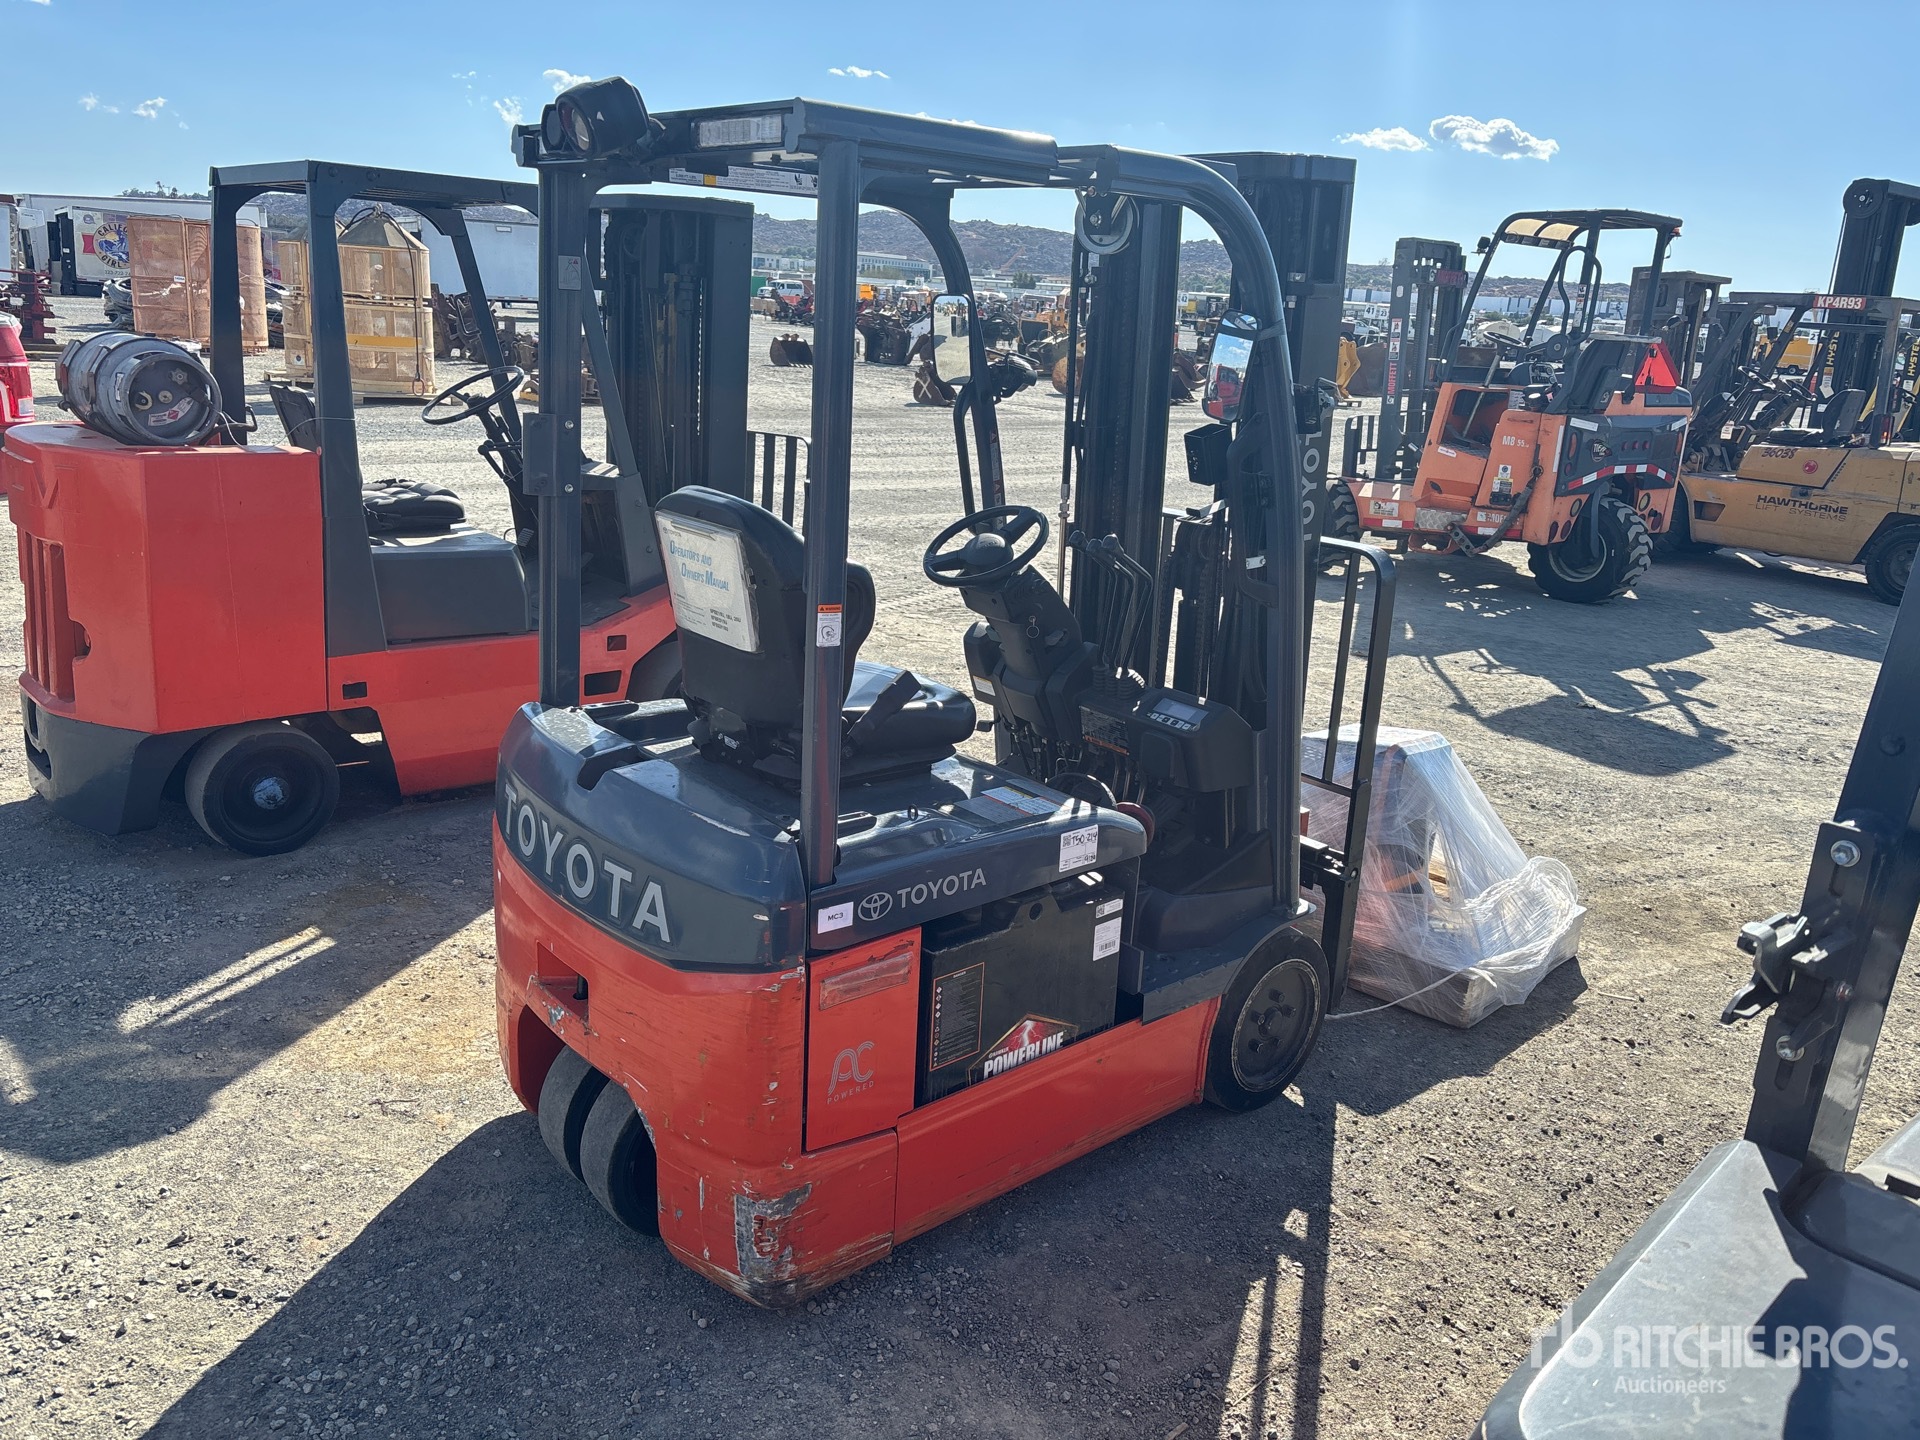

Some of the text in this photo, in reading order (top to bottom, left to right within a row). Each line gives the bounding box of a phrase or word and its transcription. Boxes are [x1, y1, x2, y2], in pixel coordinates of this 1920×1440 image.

[101, 254, 122, 268] GIRL
[1365, 306, 1375, 315] 41
[1817, 295, 1863, 309] KP4R93
[1387, 362, 1398, 395] MOFFETT
[1761, 447, 1799, 460] 36038
[1755, 503, 1847, 522] LIFT SYSTEMS
[1757, 494, 1849, 515] HAWTHORNE
[505, 783, 671, 943] TOYOTA
[897, 867, 987, 909] TOYOTA
[827, 911, 844, 921] MC3
[983, 1031, 1064, 1080] POWERLINE
[826, 1080, 875, 1105] POWERED
